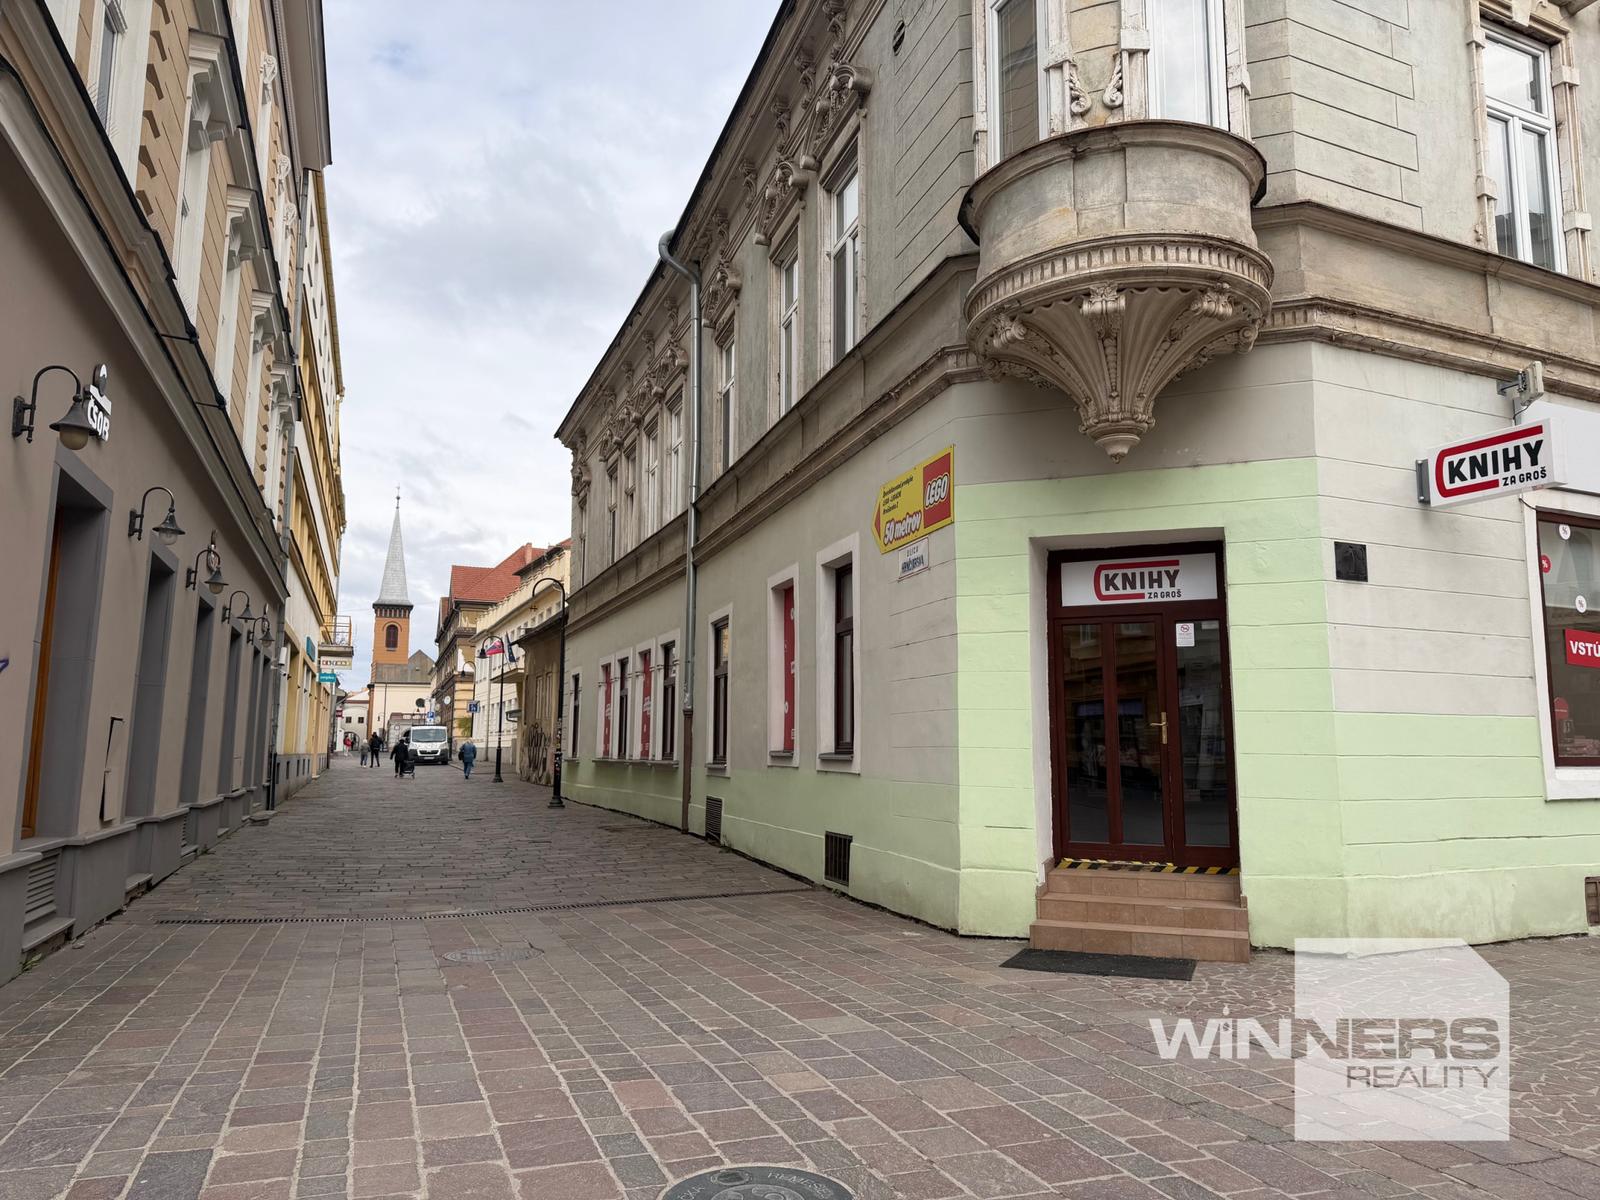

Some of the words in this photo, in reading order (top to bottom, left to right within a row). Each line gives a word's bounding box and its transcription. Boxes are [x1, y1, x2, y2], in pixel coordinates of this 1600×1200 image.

[1448, 439, 1544, 484] KNIHY
[1502, 475, 1517, 487] ZA
[1518, 466, 1547, 484] GROŠ
[925, 474, 949, 507] LEGO
[884, 519, 895, 545] 50
[895, 511, 921, 541] metrov
[1104, 569, 1180, 591] KNIHY
[1159, 589, 1182, 599] GROŠ
